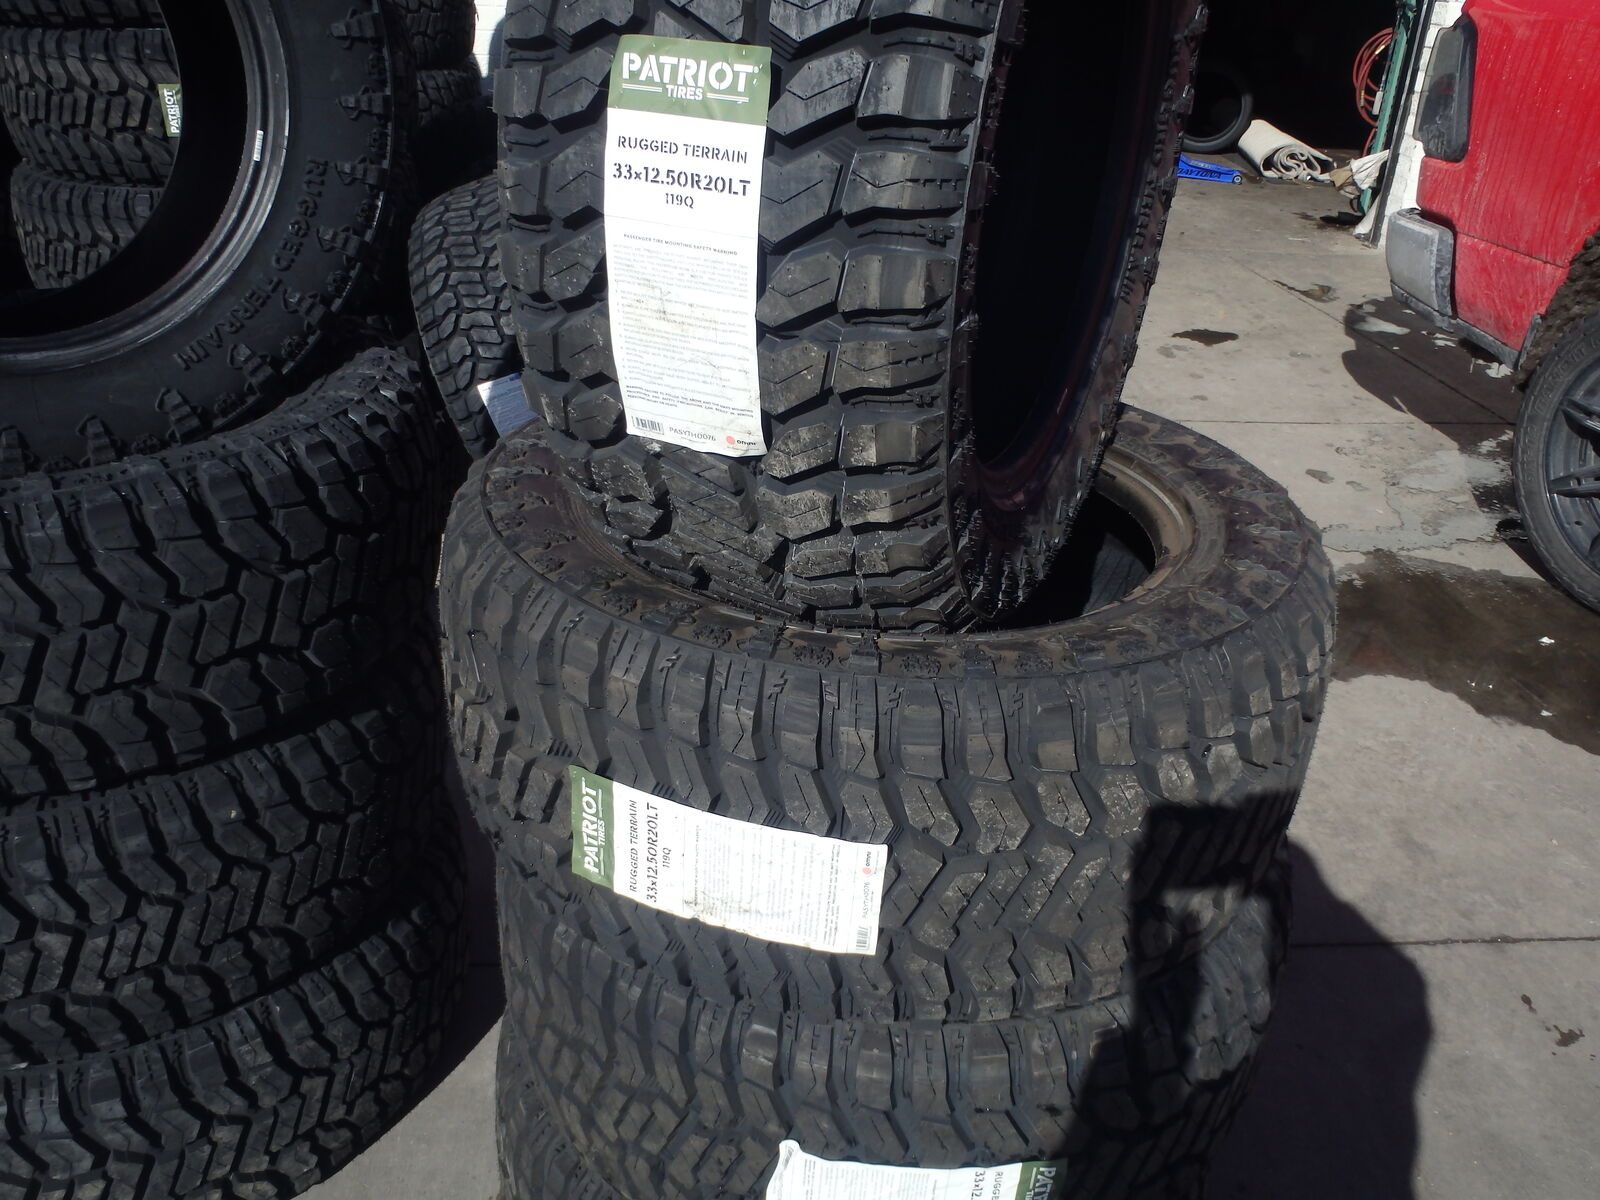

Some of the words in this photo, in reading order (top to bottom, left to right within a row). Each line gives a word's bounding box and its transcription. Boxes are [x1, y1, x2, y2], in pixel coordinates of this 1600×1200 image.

[622, 52, 755, 93] PATRIOT
[164, 88, 180, 133] PATRIOT
[666, 84, 703, 101] TIRES
[618, 135, 679, 155] RUGGED
[683, 143, 747, 164] TERRAIN
[612, 162, 751, 196] 33x12.50R20LT
[665, 192, 694, 209] 119Q
[581, 778, 600, 873] PATRIOT
[598, 820, 606, 845] TIRES
[629, 799, 638, 845] TERRAIN
[629, 848, 638, 892] RUGGED
[646, 802, 659, 903] 33x12.50R20LT
[662, 847, 672, 869] 119Q
